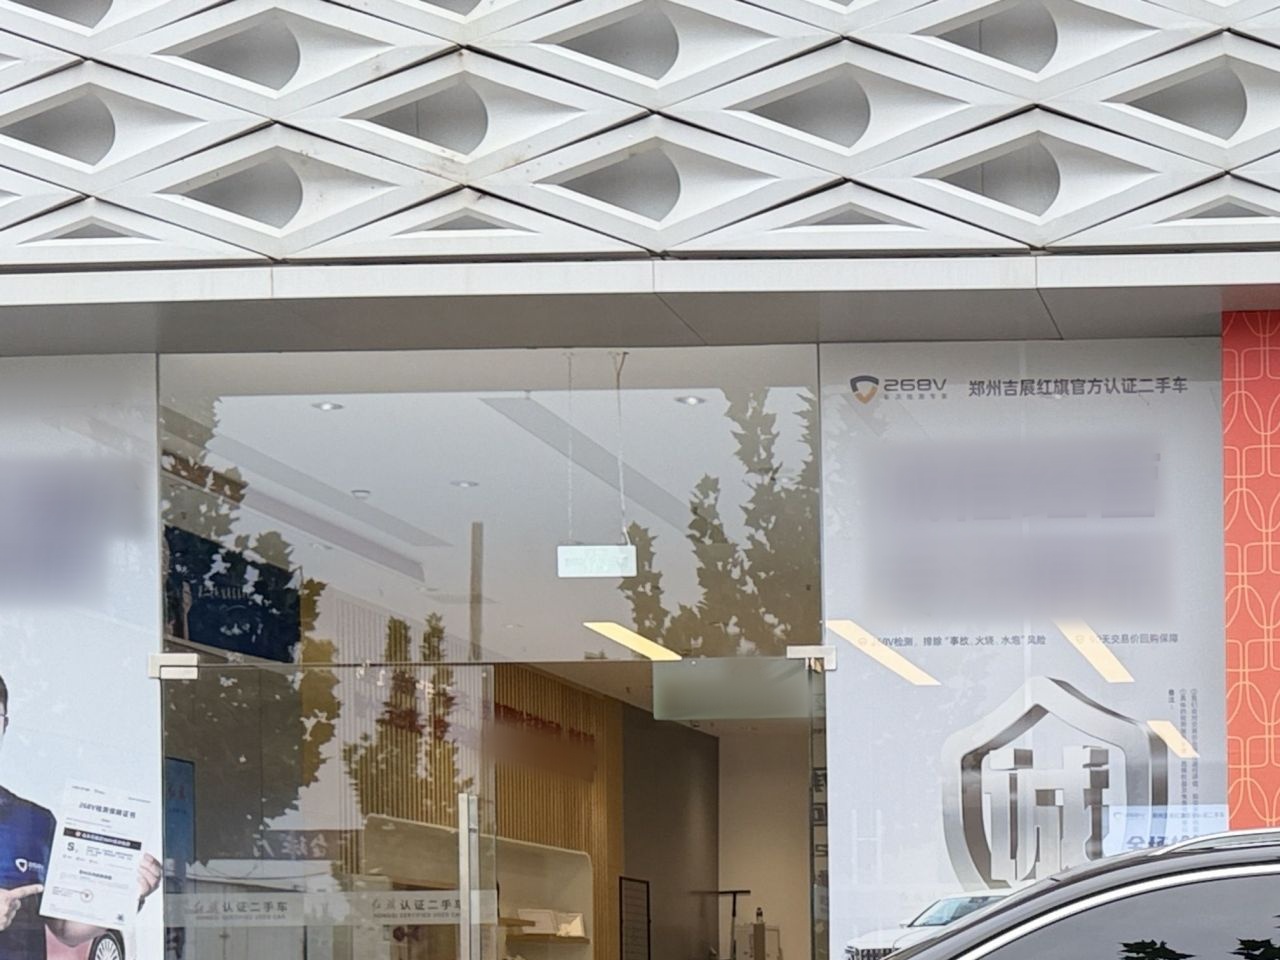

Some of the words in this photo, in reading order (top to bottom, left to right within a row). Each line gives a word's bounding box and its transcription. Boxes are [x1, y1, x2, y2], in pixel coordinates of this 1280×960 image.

[884, 378, 947, 391] 268V
[968, 376, 1189, 397] 郑州吉展红旗官方认证二手车
